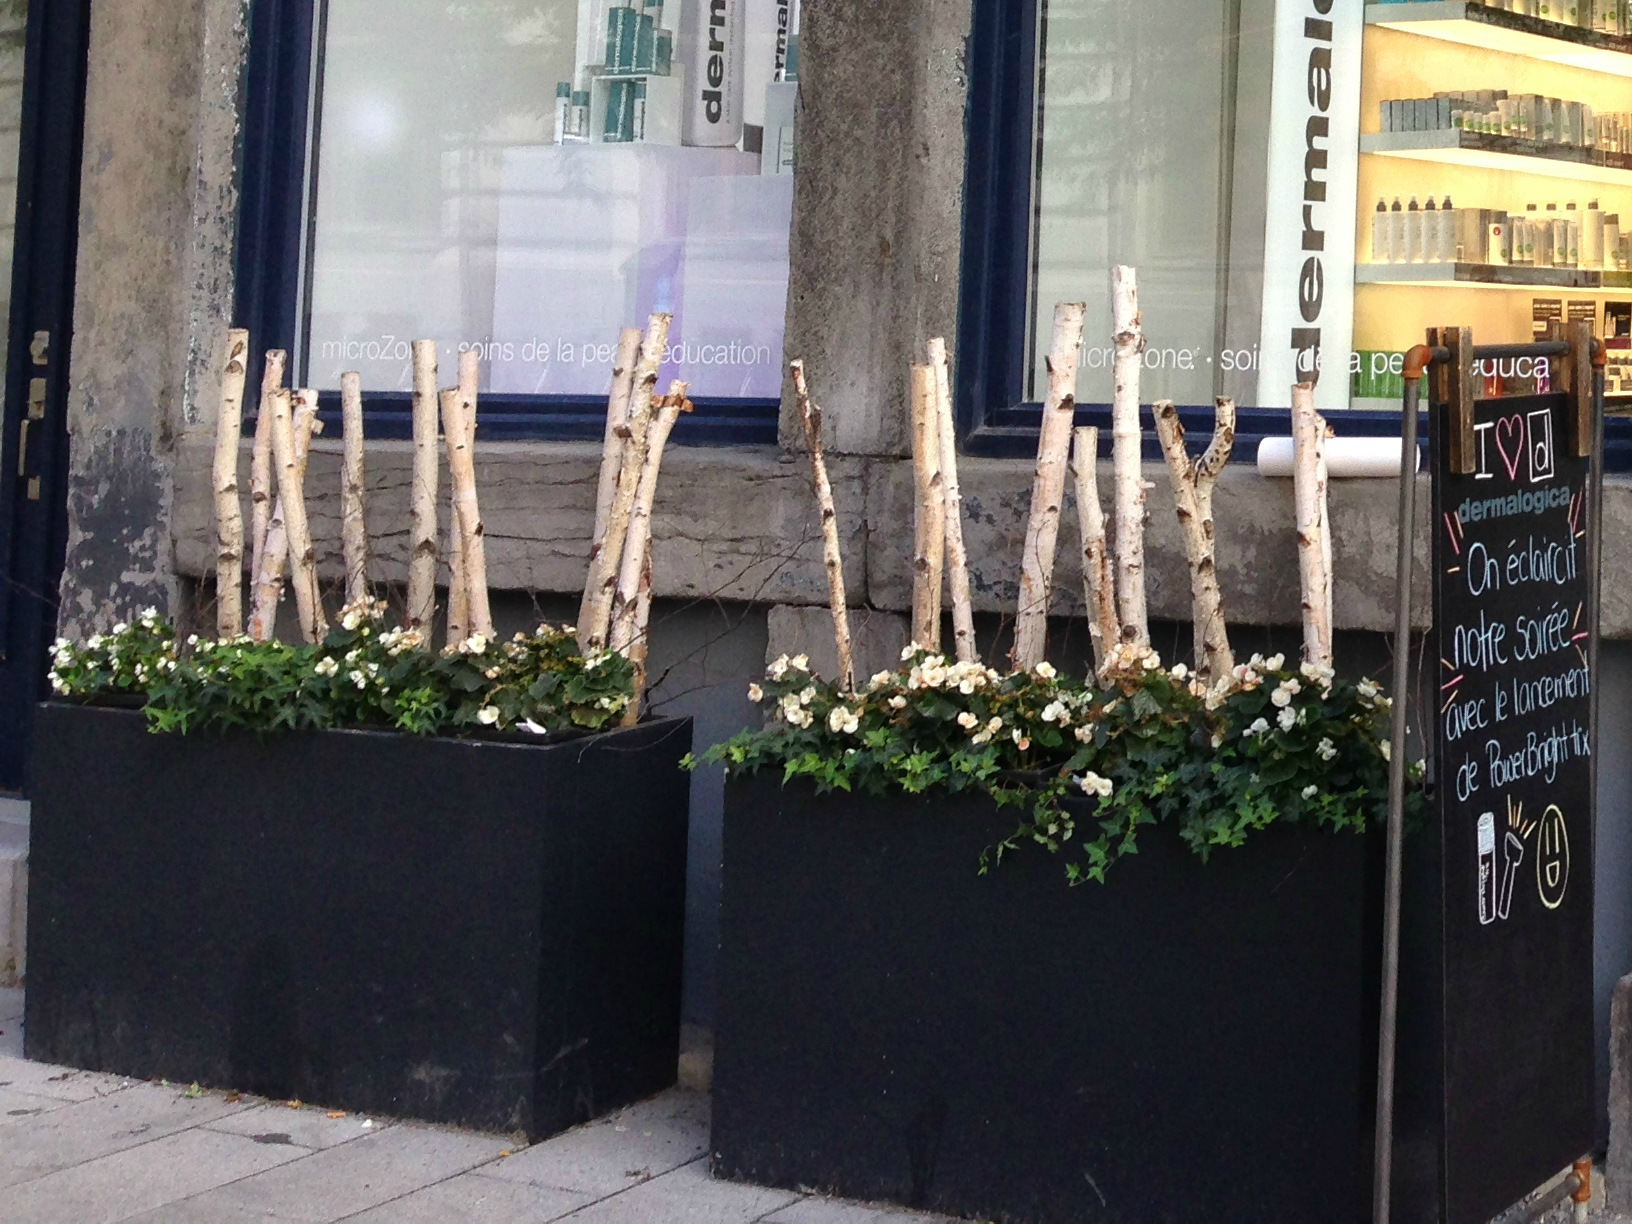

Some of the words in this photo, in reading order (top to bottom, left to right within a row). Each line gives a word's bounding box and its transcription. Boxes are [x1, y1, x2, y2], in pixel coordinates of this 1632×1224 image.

[322, 335, 412, 361] microZo
[522, 337, 550, 362] de
[557, 337, 575, 362] la
[582, 341, 617, 368] pea
[1473, 422, 1494, 479] I
[1458, 485, 1572, 524] dermalogica
[1467, 541, 1500, 596] On
[1506, 523, 1577, 585] éclaircit
[1454, 608, 1508, 672] notre
[1446, 697, 1488, 742] avec
[1495, 681, 1508, 722] le
[1514, 649, 1590, 716] lancement
[1456, 752, 1480, 802] de
[1485, 726, 1569, 784] PowerBright
